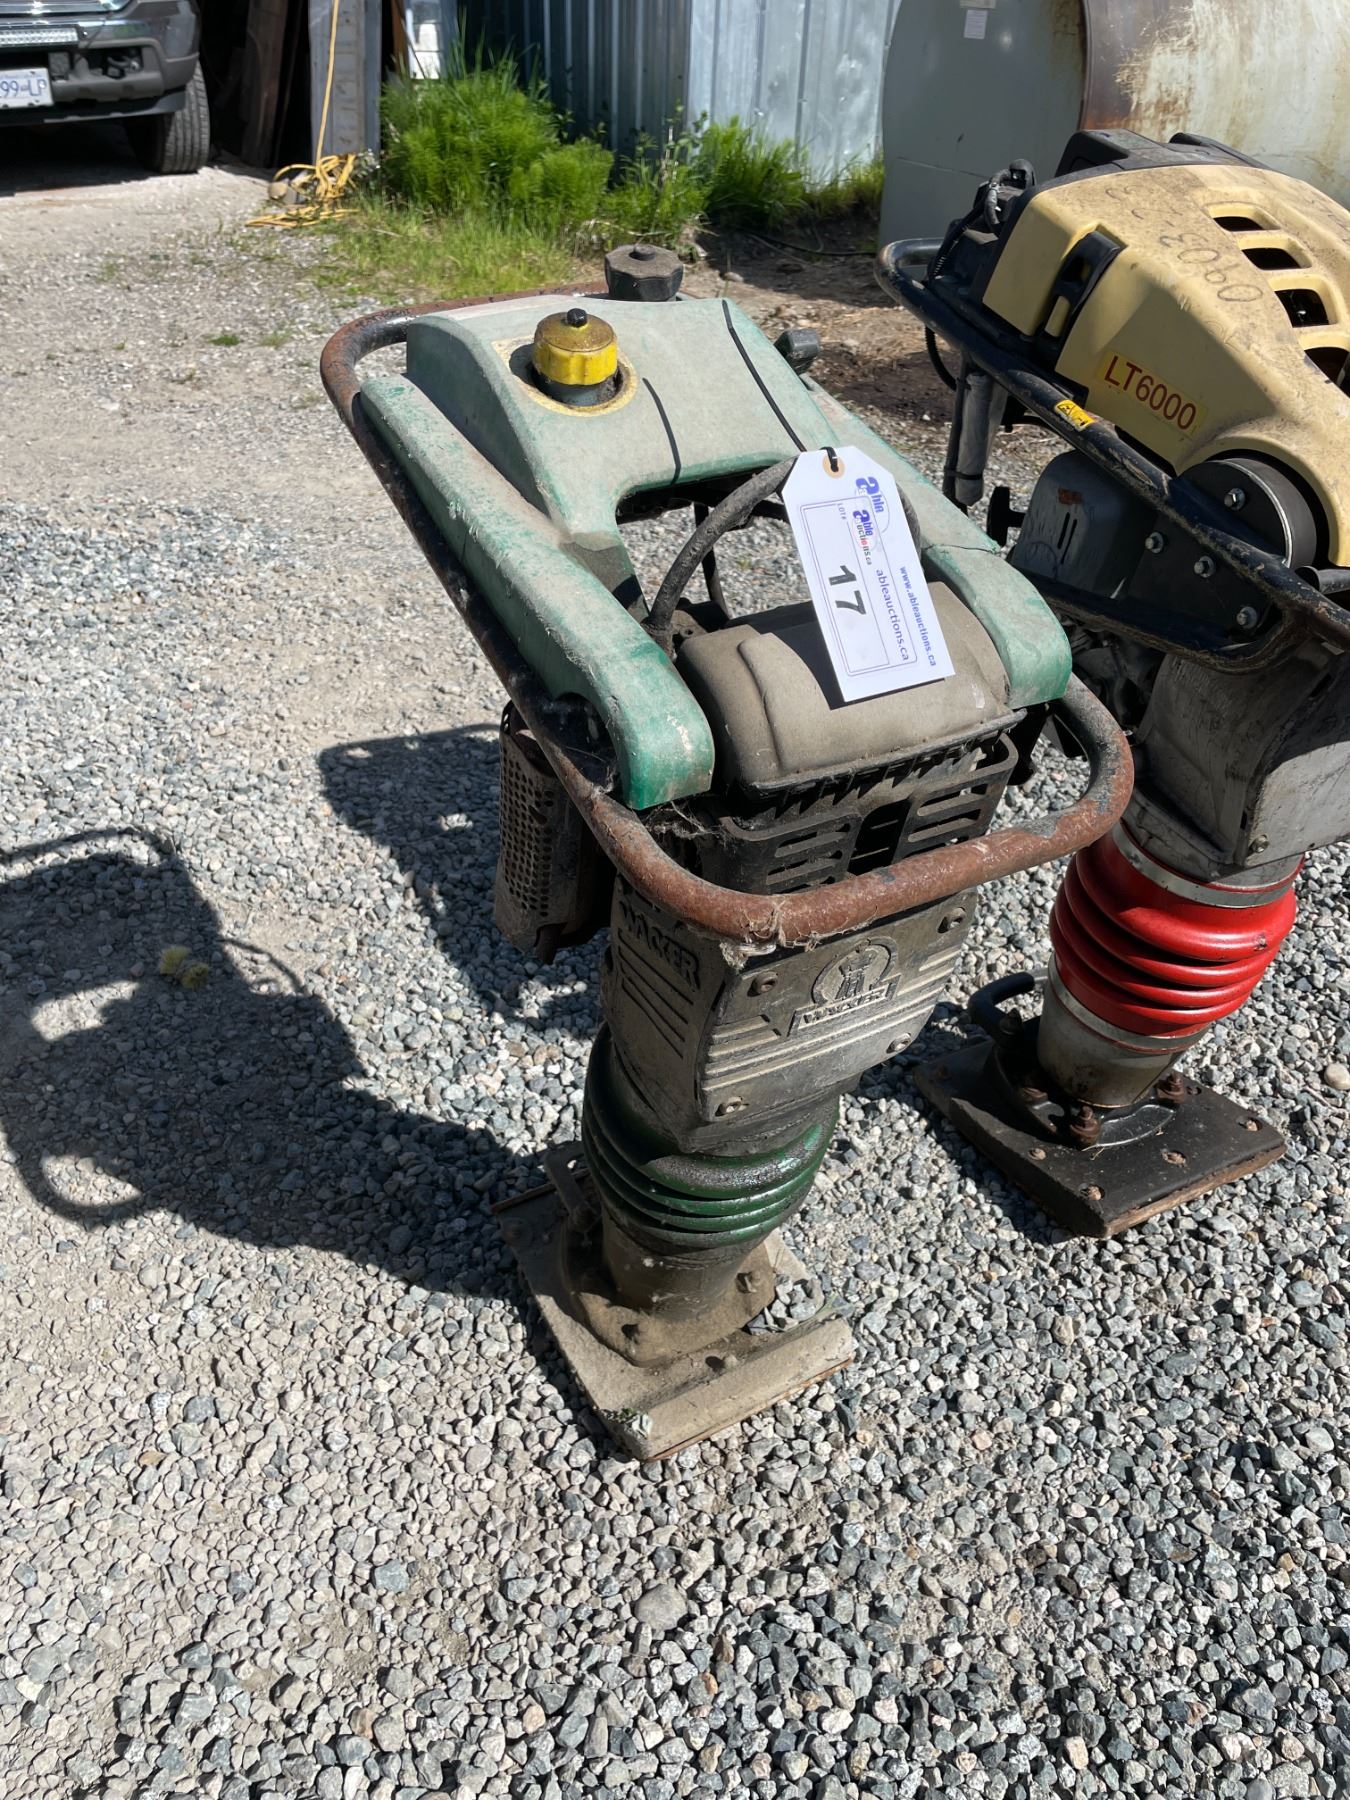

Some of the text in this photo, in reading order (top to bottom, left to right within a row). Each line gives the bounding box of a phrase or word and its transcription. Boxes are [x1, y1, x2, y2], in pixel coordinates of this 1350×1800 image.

[1104, 355, 1197, 431] LT6000
[828, 564, 867, 616] 17
[876, 568, 910, 661] ableauctions.ca
[899, 566, 937, 667] www.ableauctions.ca
